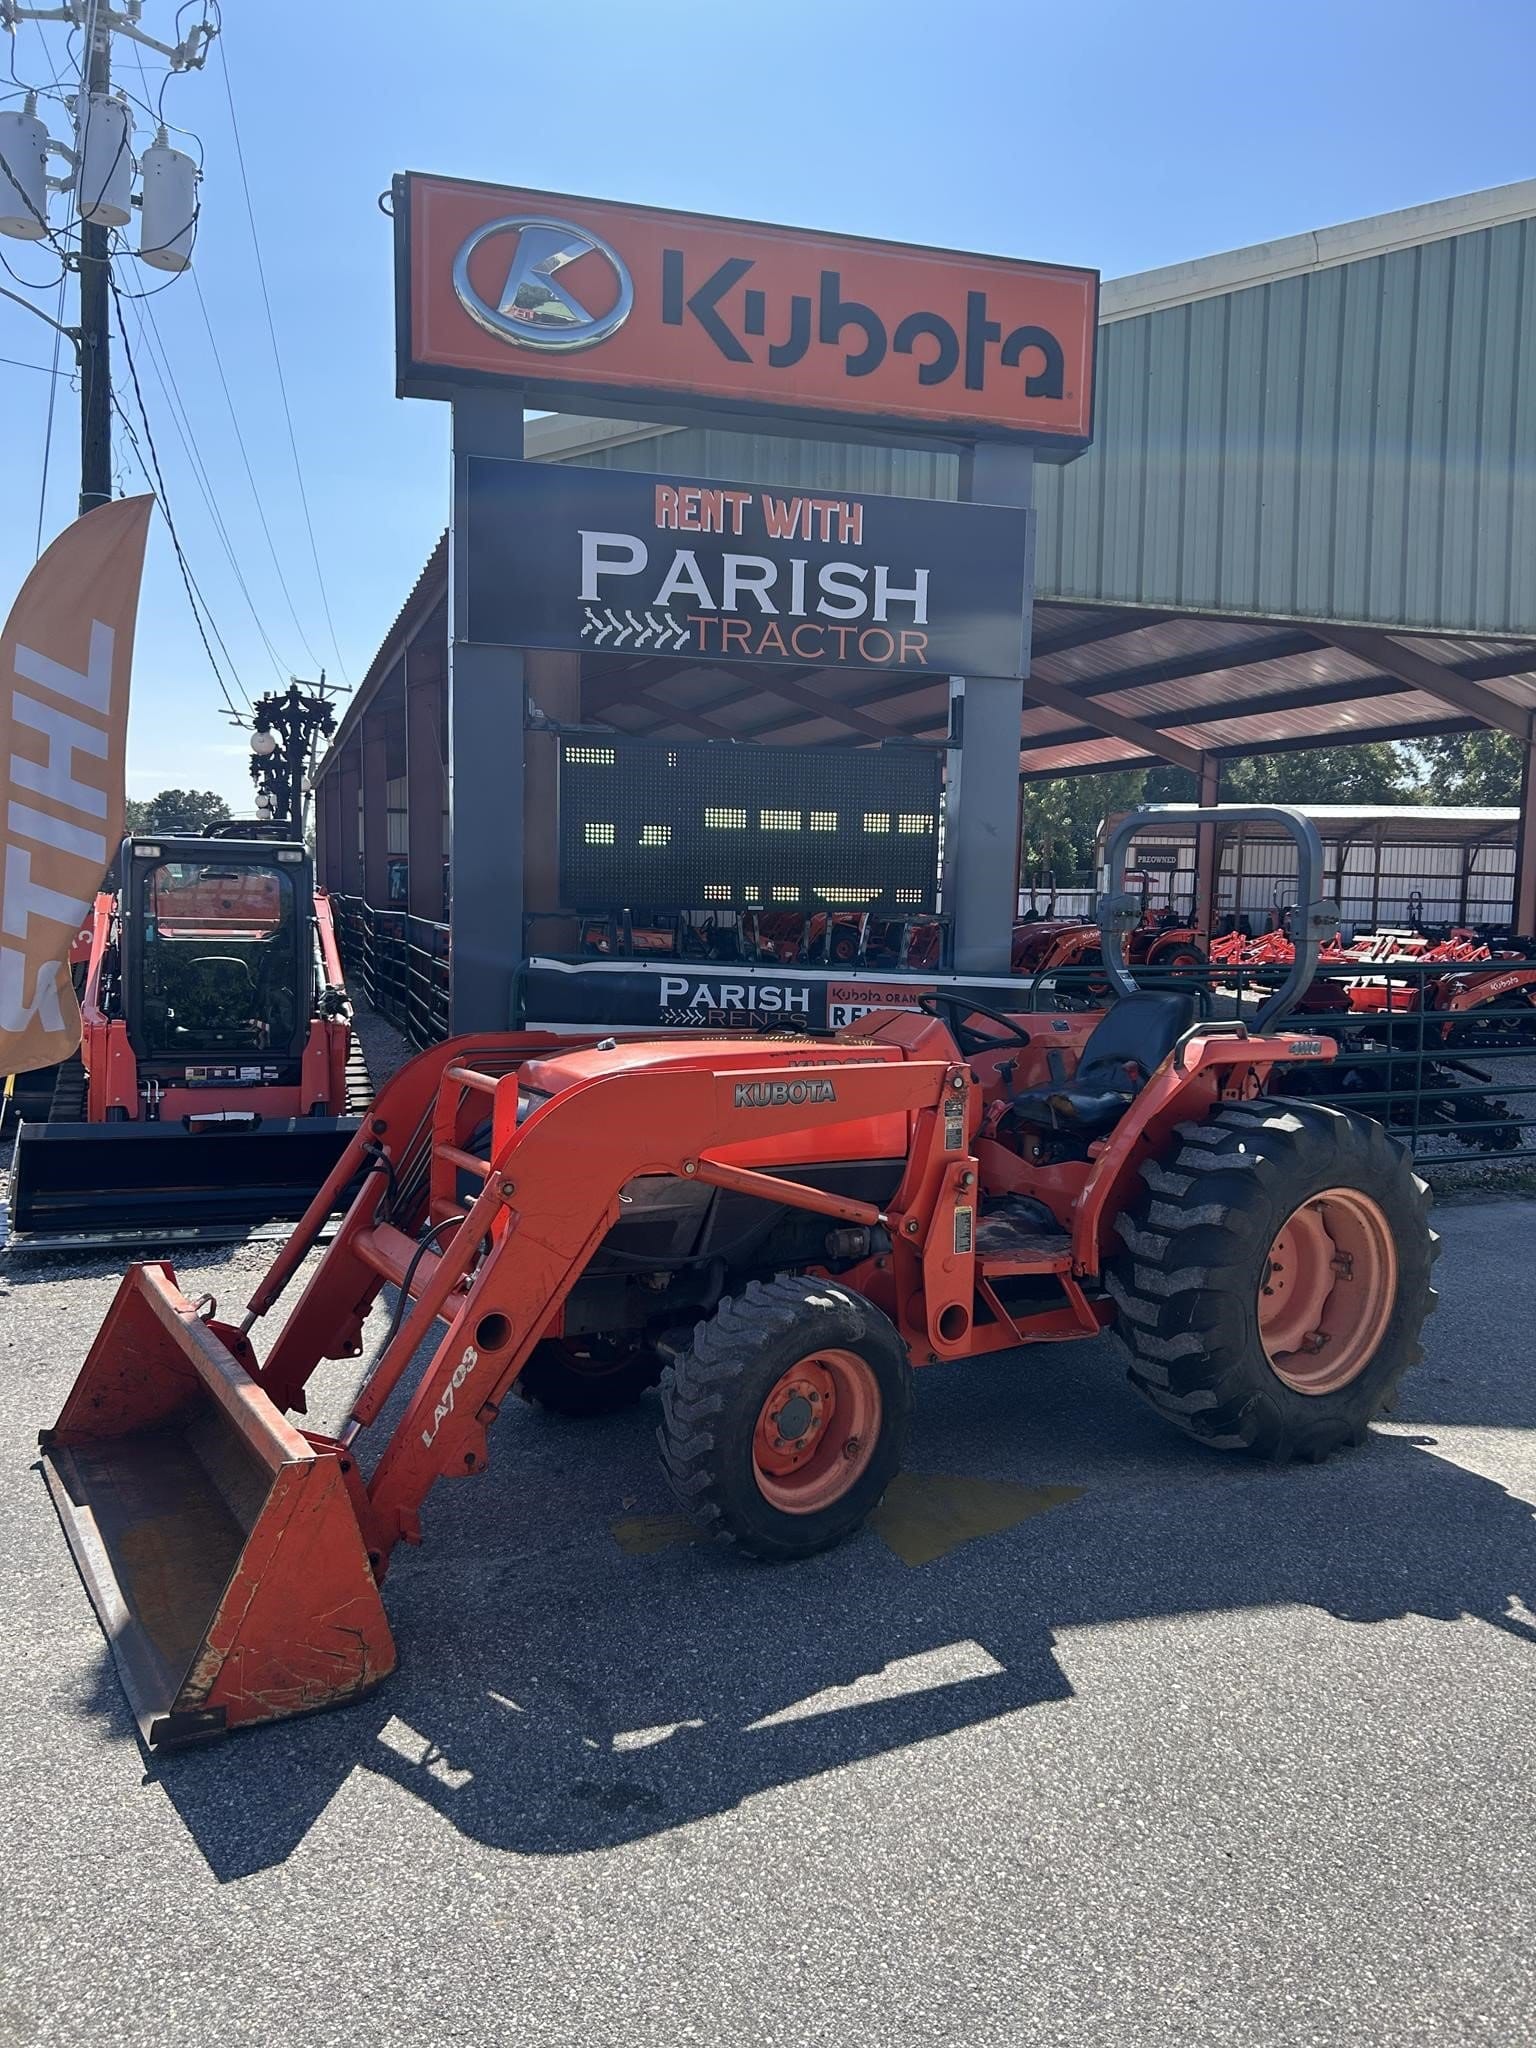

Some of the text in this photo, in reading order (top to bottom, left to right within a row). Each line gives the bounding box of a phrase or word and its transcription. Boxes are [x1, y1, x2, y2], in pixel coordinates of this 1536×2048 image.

[661, 248, 1065, 399] Kubota
[655, 484, 864, 545] RENT WITH
[576, 529, 931, 625] PARISH
[686, 614, 930, 665] TRACTOR
[0, 619, 115, 1032] STIHL
[1137, 855, 1177, 864] PREOWNED
[659, 976, 810, 1012] PARISH
[832, 988, 931, 1004] Kubota ORAN
[734, 1079, 836, 1107] KUBOTA
[421, 1345, 478, 1448] LA703
